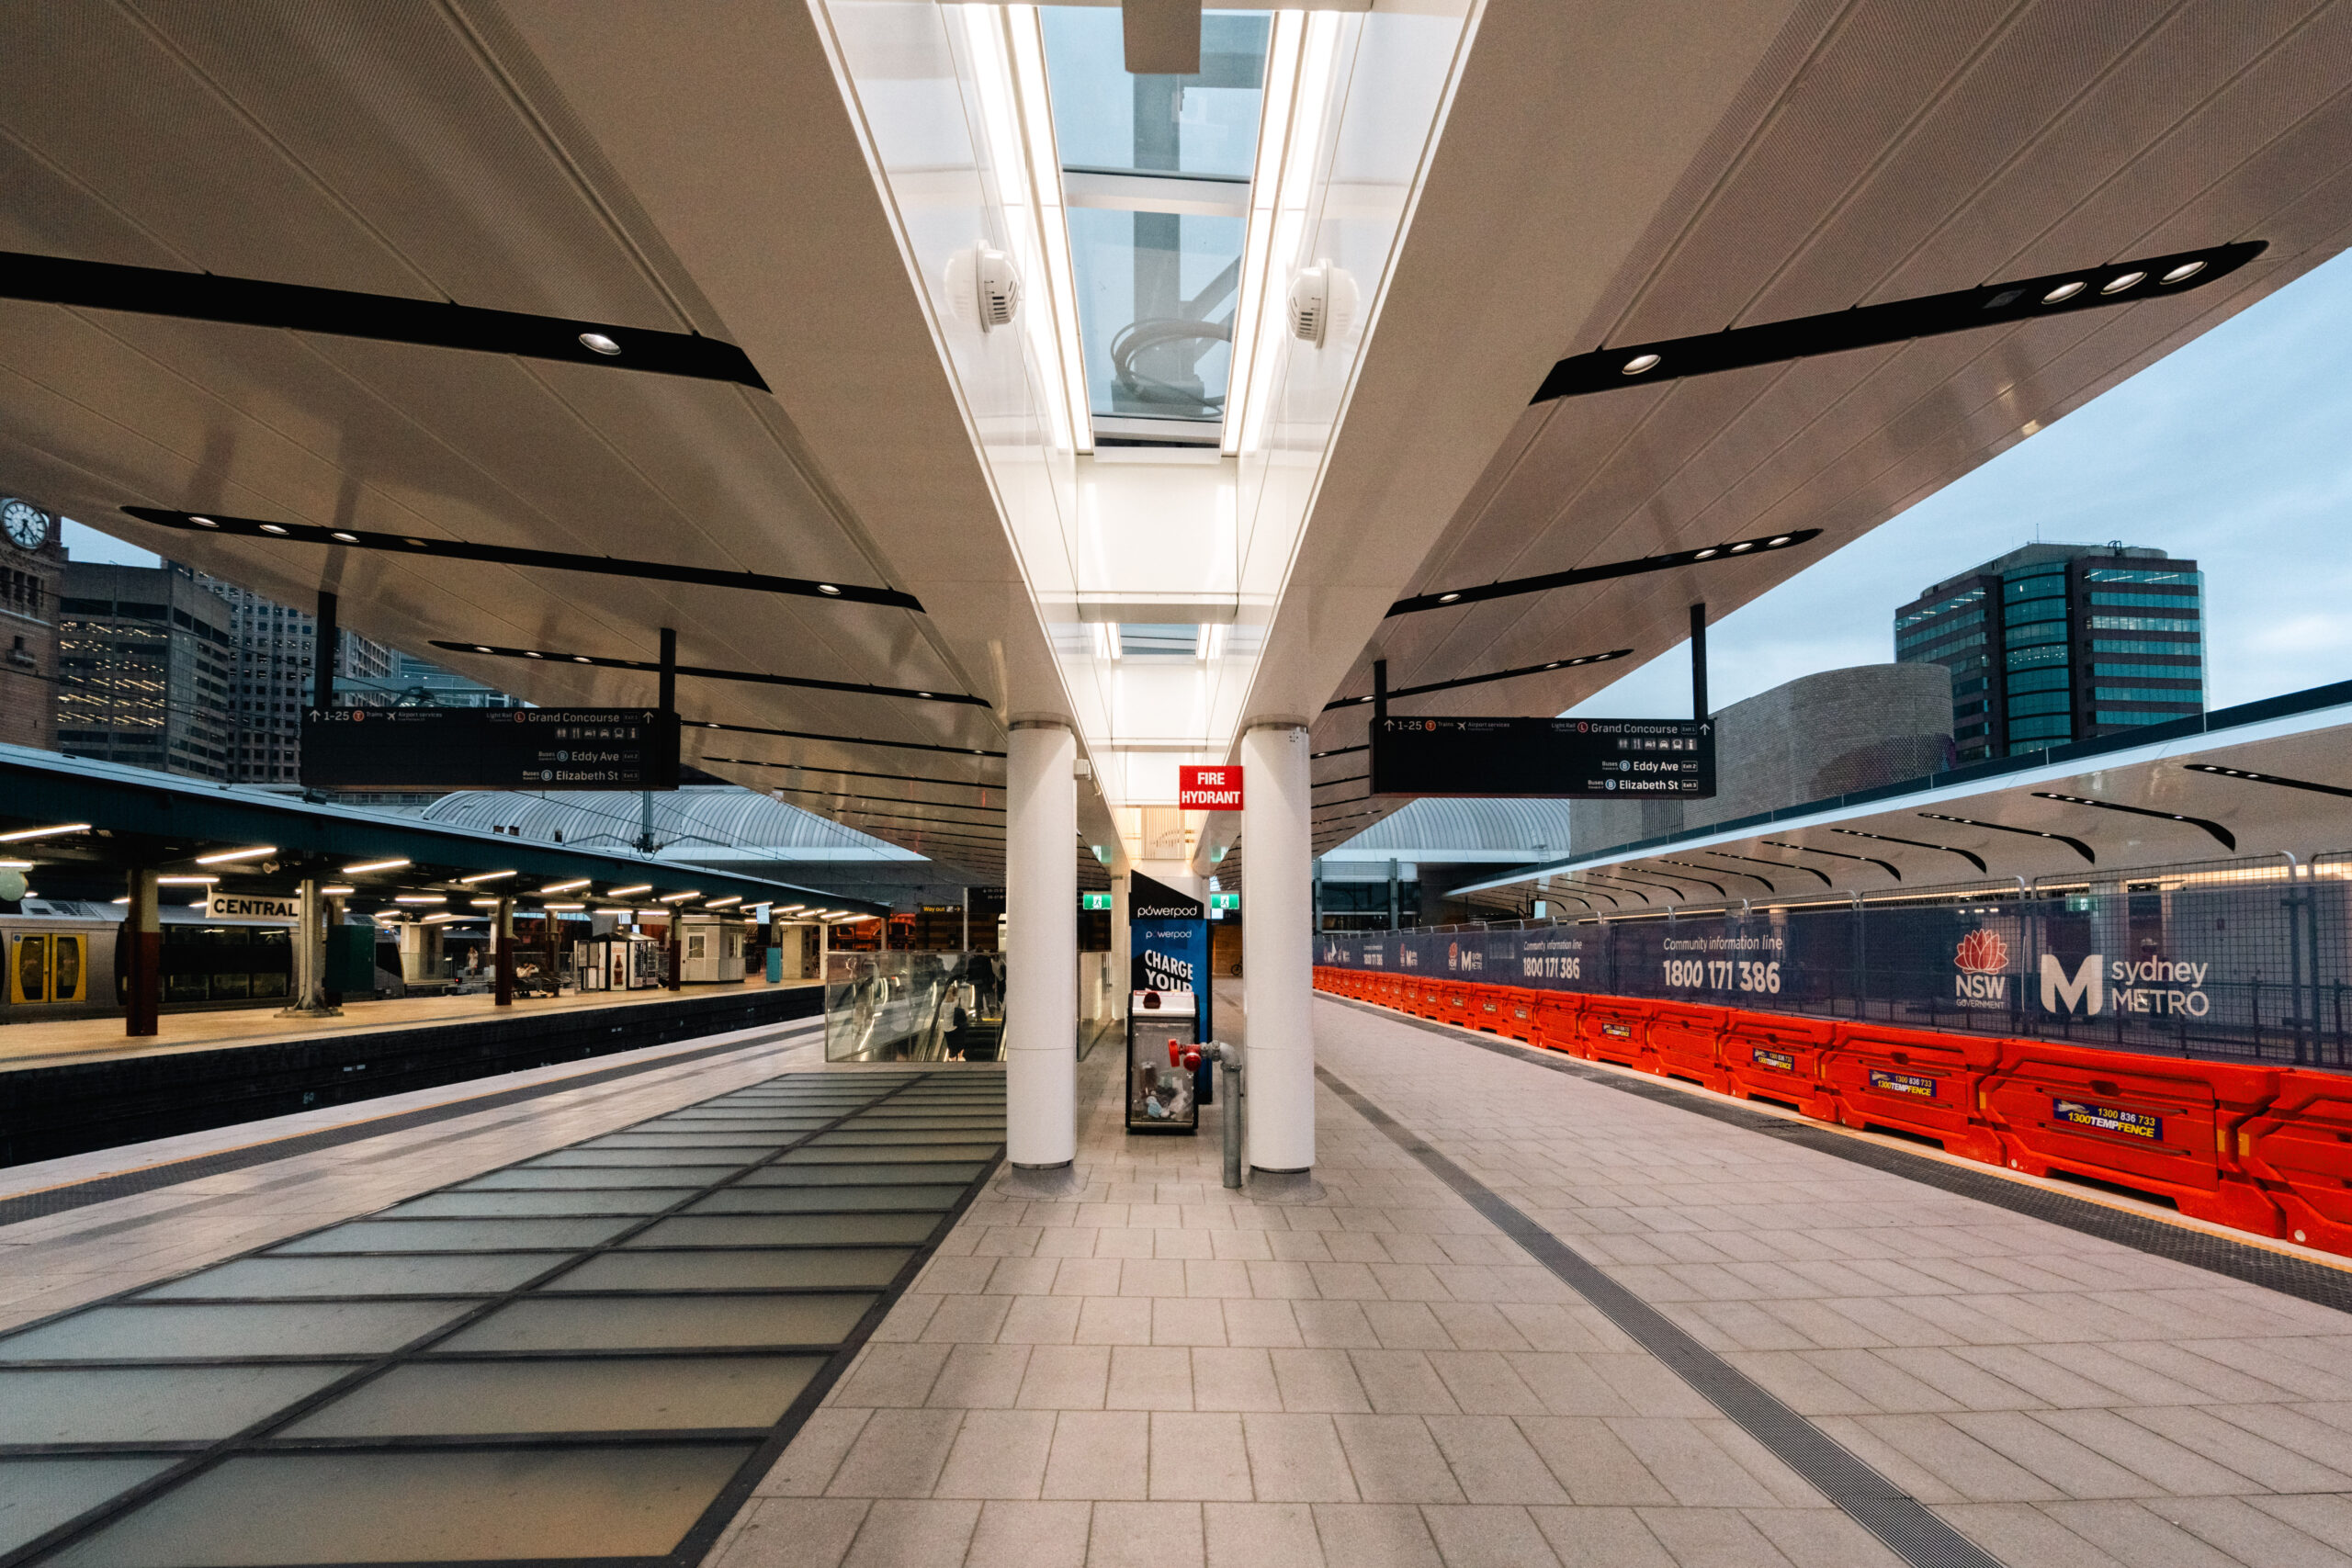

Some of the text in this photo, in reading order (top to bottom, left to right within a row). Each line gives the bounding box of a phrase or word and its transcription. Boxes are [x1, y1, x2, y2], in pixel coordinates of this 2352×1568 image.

[323, 711, 350, 721] 1-25
[528, 713, 560, 722] Grand
[562, 713, 620, 722] Concourse
[1397, 721, 1422, 730] 1-25
[1591, 723, 1622, 733] Grand
[1623, 724, 1678, 734] Concourse
[571, 751, 597, 763] Eddy
[599, 751, 619, 761] Ave
[1634, 761, 1658, 773] Eddy
[1660, 761, 1679, 772] Ave
[556, 771, 605, 781] Elizabeth
[607, 771, 618, 781] St
[1197, 772, 1225, 785] FIRE
[1619, 780, 1666, 790] Elizabeth
[1668, 780, 1679, 790] St
[1181, 790, 1240, 804] HYDRANT
[213, 898, 299, 917] CENTRAL
[1137, 905, 1197, 918] powerpod
[1523, 940, 1582, 952] Community information line
[1663, 934, 1783, 953] Community information line
[1145, 949, 1193, 980] CHARGE
[1523, 956, 1580, 979] 1800 171 386
[2111, 955, 2209, 987] sydney
[1146, 968, 1193, 992] YOUR
[1663, 960, 1781, 994] 1800 171 386
[1956, 975, 2006, 999] NSW
[2041, 954, 2103, 1015] M
[1956, 999, 2006, 1010] GOVERNMENT
[2112, 987, 2210, 1016] METRO
[1878, 1079, 1932, 1096] 1300TEMPFENCE
[1895, 1075, 1932, 1088] 1300 836 733
[2098, 1108, 2155, 1126] 1300 836 733
[2067, 1111, 2154, 1138] 1300TEMPFENCE
